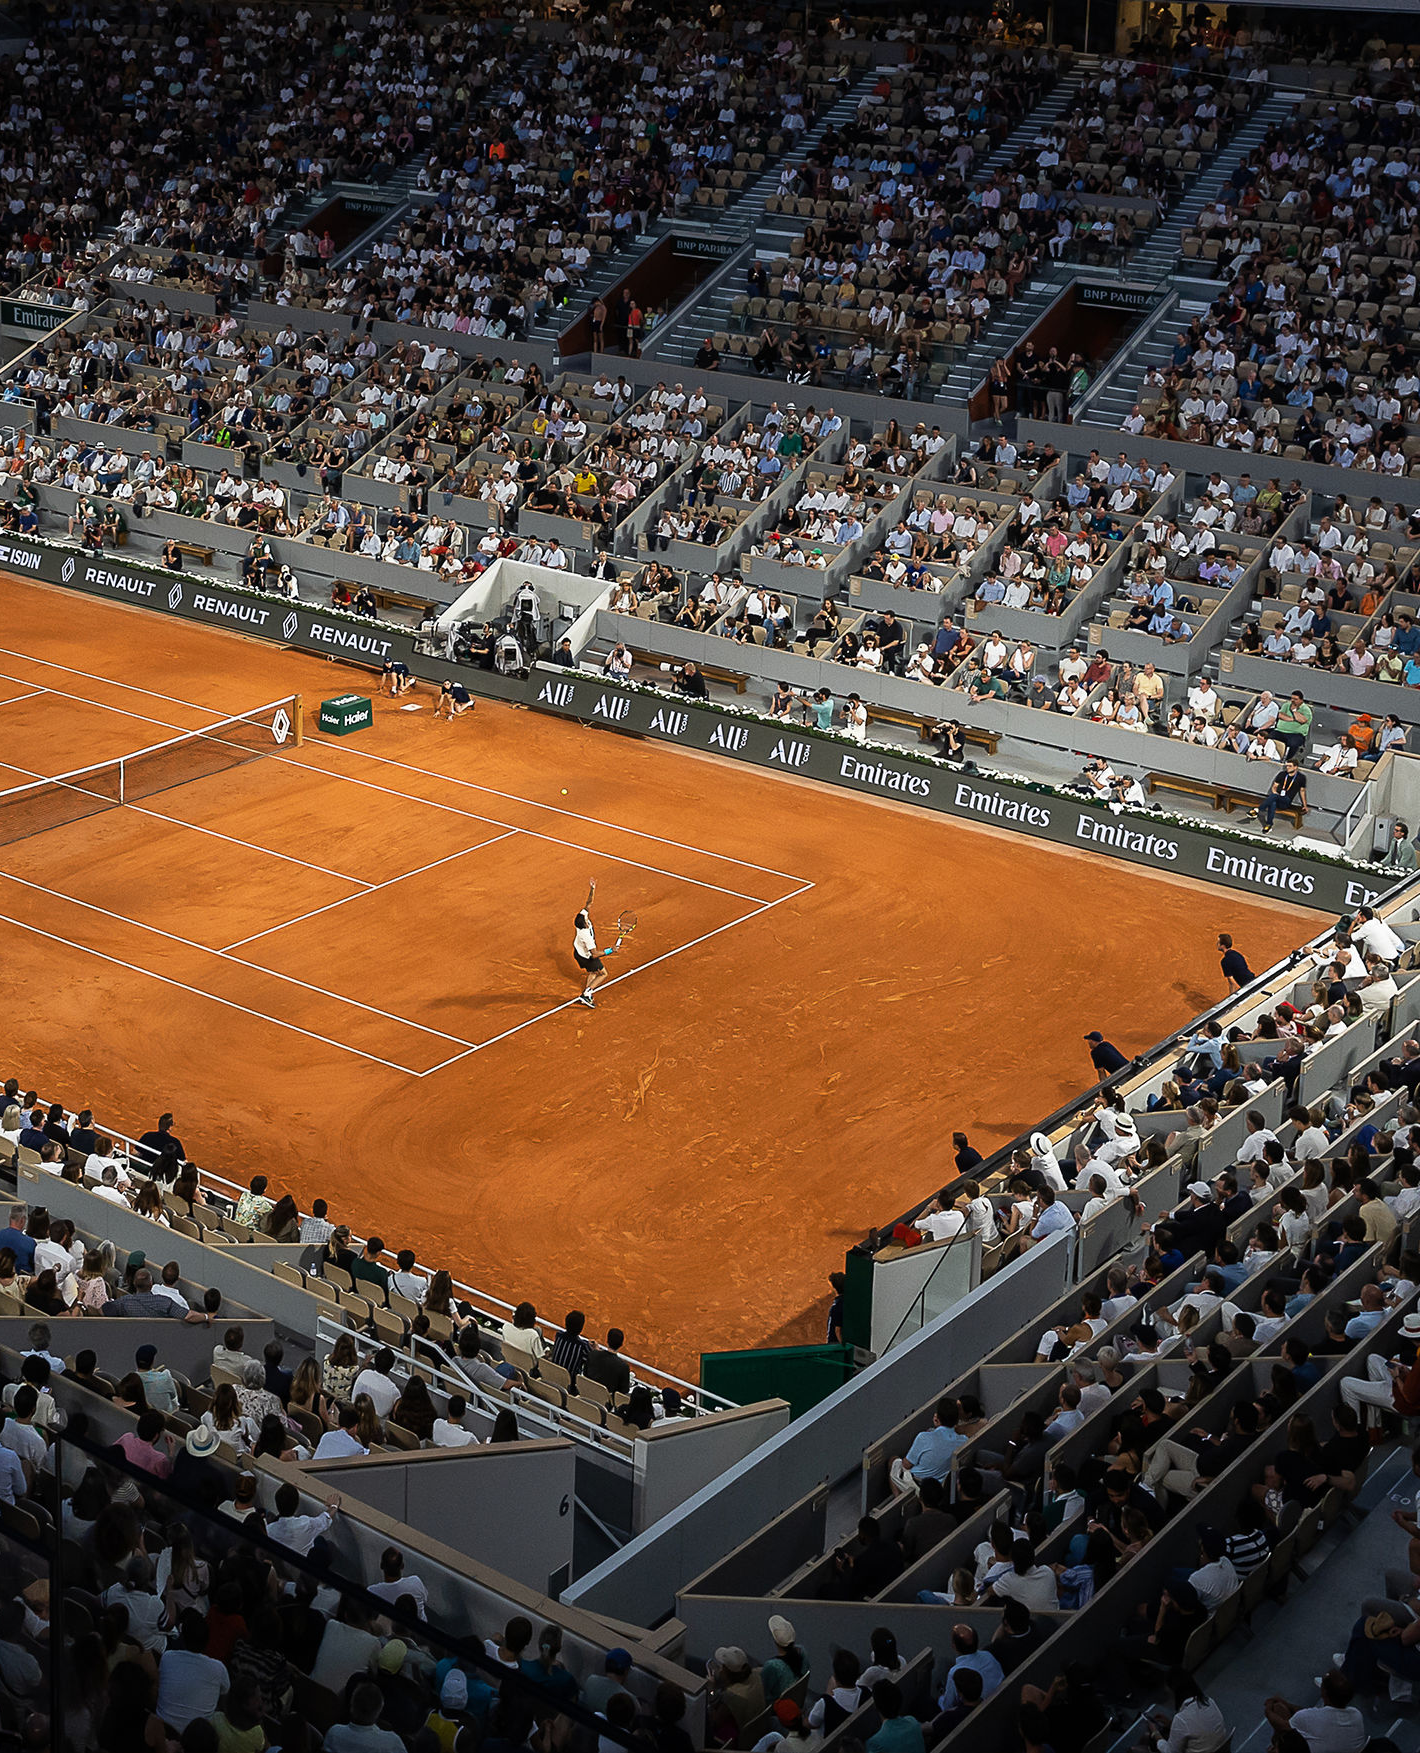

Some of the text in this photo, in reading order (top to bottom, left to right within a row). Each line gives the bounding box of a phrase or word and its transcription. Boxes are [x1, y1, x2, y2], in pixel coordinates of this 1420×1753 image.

[677, 240, 696, 250] BNP
[1083, 289, 1108, 300] BNP
[10, 549, 41, 570] ISDIN
[84, 567, 157, 597] RENAULT
[193, 594, 270, 626] RENAULT
[309, 623, 392, 657] RENAULT
[344, 710, 369, 727] Haier
[840, 754, 930, 797] Emirates
[954, 783, 1051, 827] Emirates
[1076, 814, 1178, 861] Emirates
[1206, 846, 1315, 895] Emirates
[559, 1494, 569, 1517] 6
